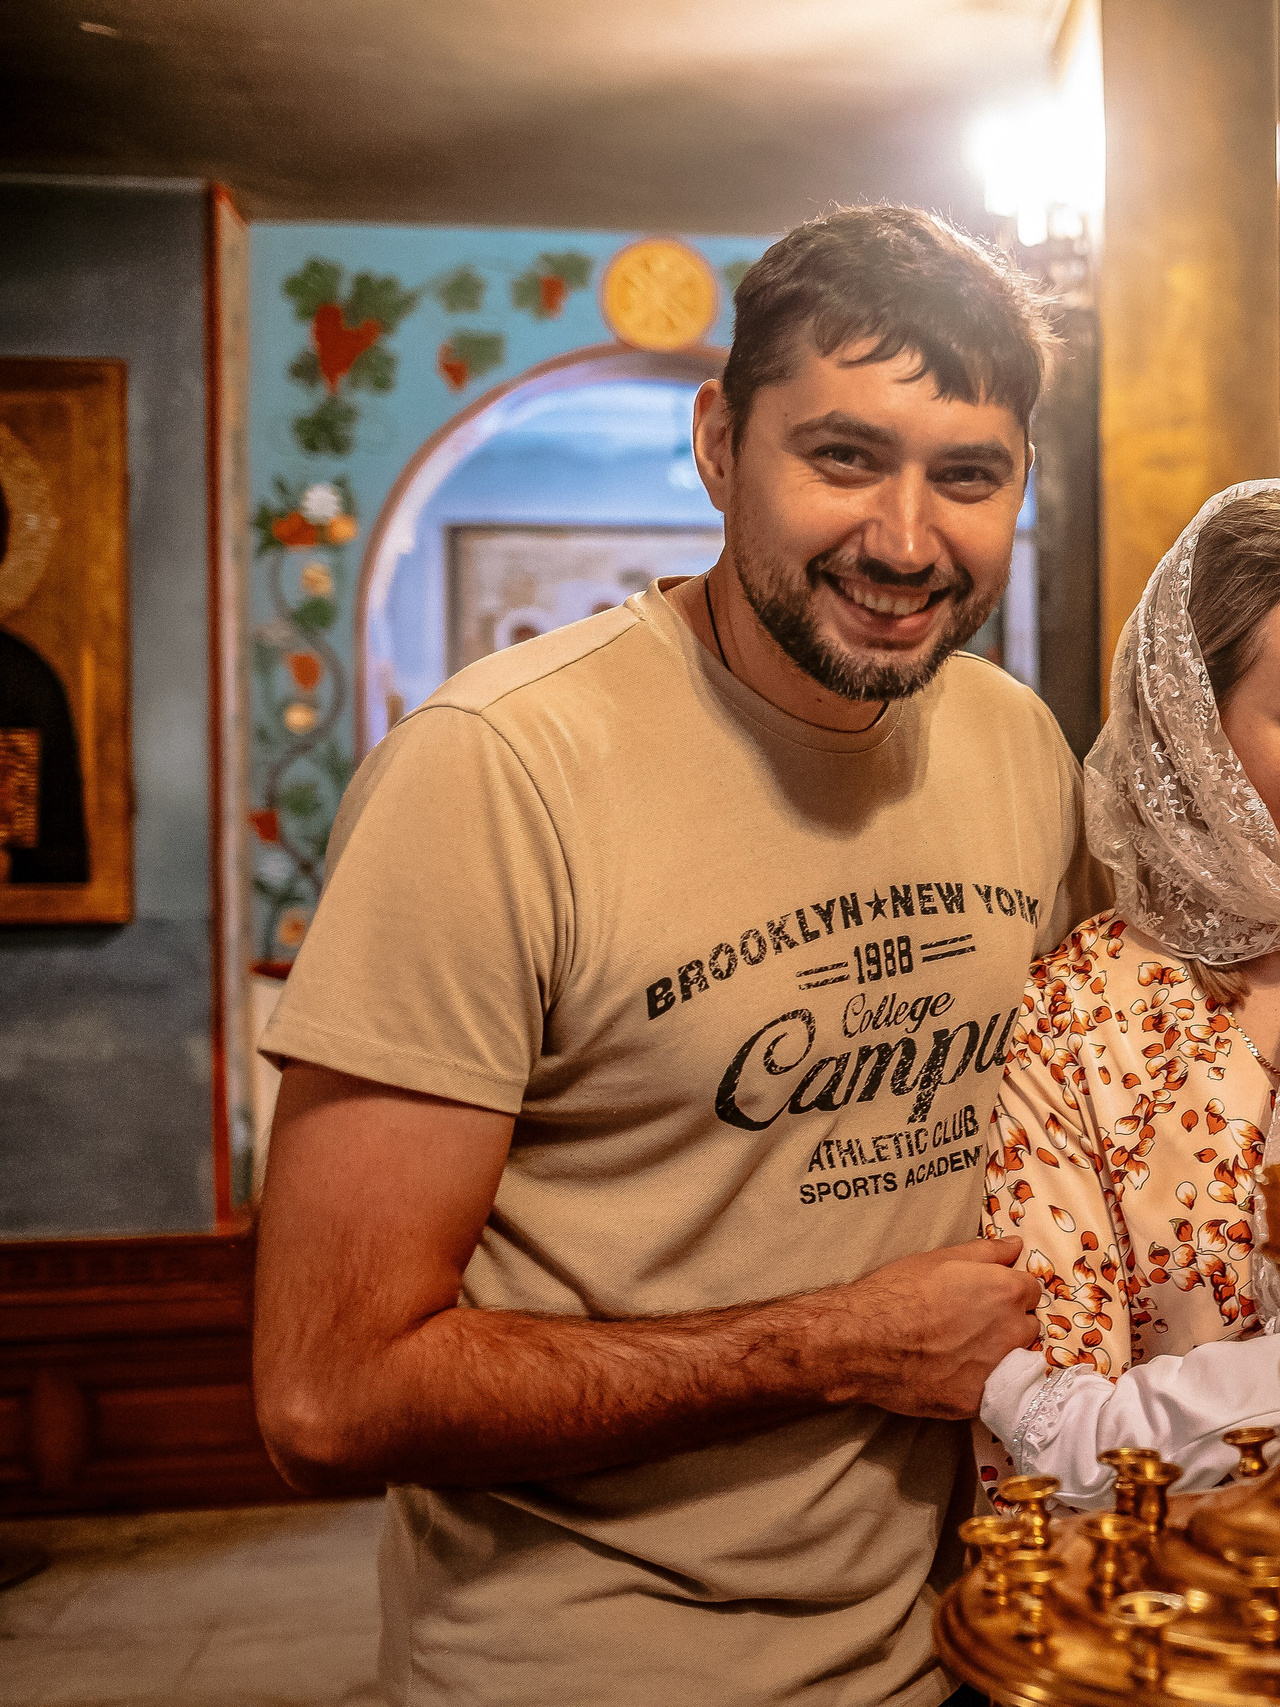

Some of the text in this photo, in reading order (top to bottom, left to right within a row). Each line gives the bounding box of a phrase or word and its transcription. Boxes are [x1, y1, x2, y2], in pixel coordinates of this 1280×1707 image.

[646, 892, 864, 1021] BROOKLYN
[889, 882, 966, 919] NEW
[854, 935, 914, 985] 1988
[842, 992, 956, 1038] College
[808, 1104, 979, 1172] ATHLETIC CLUB
[800, 1172, 898, 1204] SPORTS
